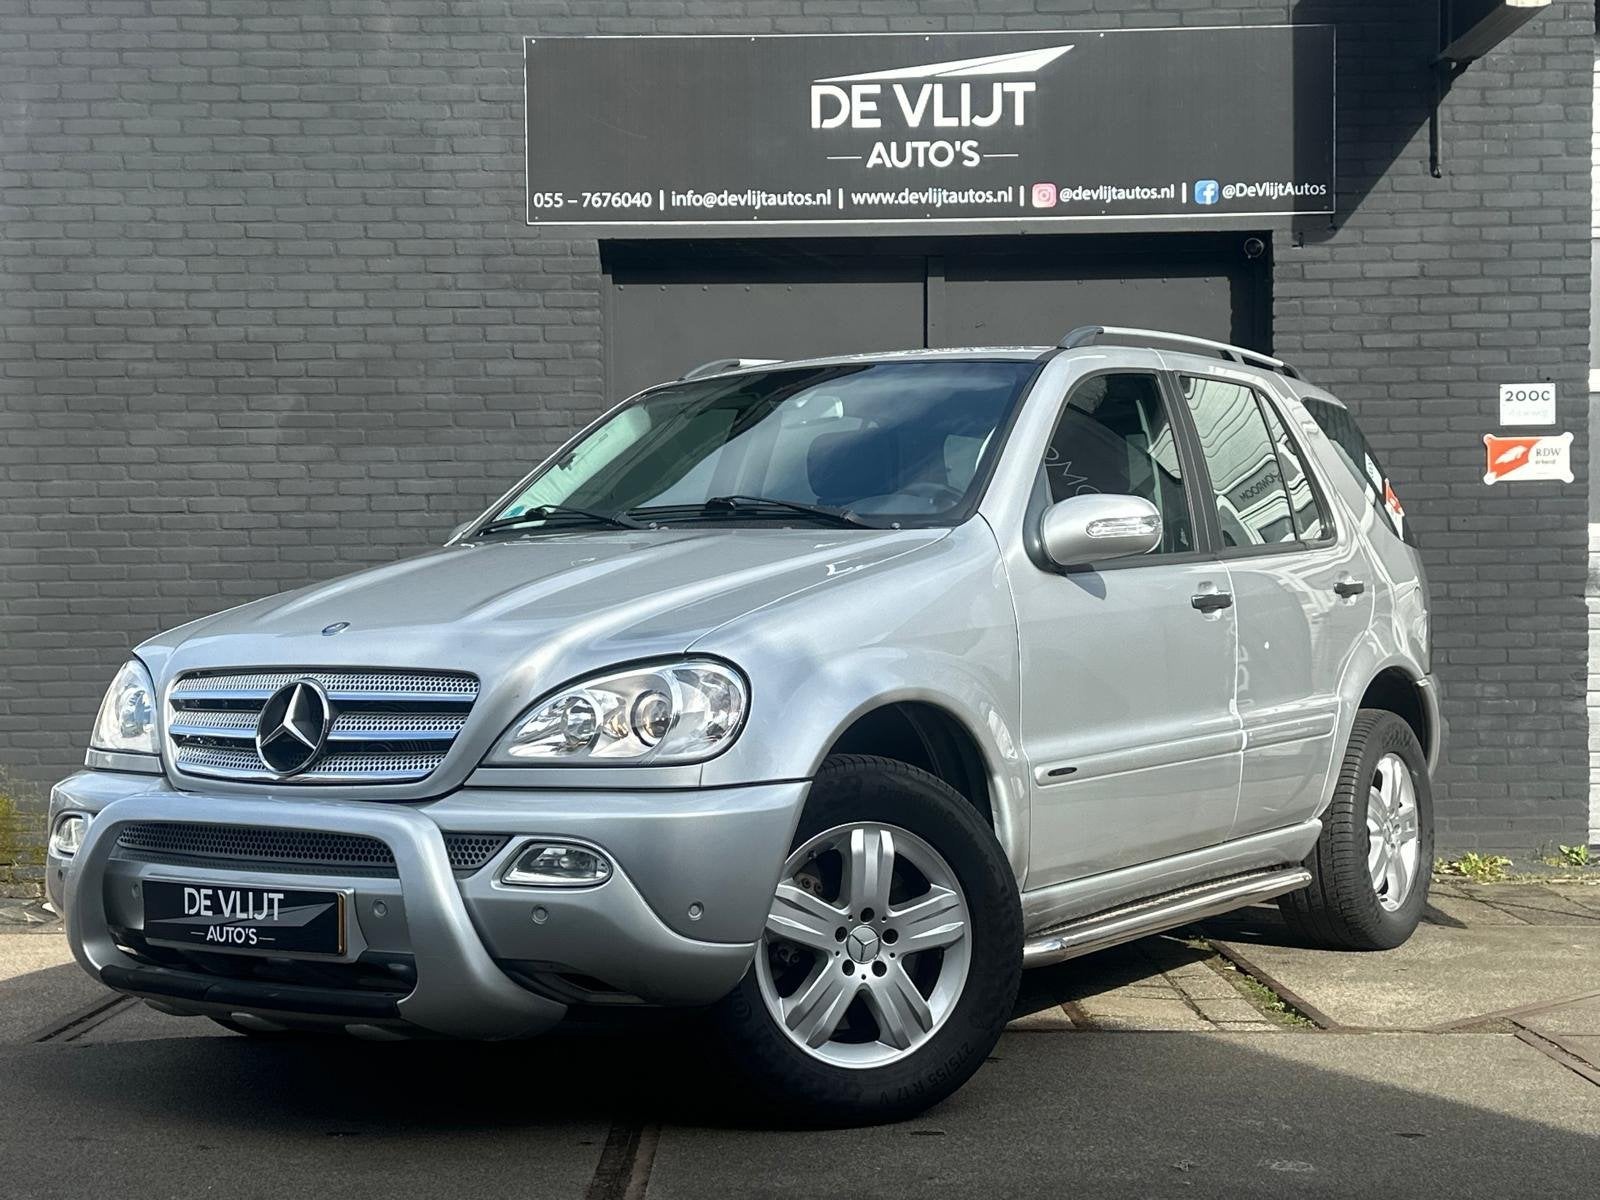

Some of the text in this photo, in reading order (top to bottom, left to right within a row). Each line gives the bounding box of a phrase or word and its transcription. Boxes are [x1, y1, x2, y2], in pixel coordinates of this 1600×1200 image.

[811, 82, 1036, 128] DE VLIJT
[866, 140, 980, 168] AUTO'S
[533, 192, 563, 209] 055
[582, 192, 652, 209] 7676040
[671, 188, 831, 210] info@devlijtautos.nl
[851, 186, 1012, 208] www.devlijtautos.nl
[1059, 184, 1174, 204] @devlijtautos.nl
[1222, 181, 1327, 200] @DeVlijtAutos
[1536, 447, 1562, 457] RDW
[184, 887, 284, 921] DE VLIJT
[206, 925, 257, 945] AUTO'S
